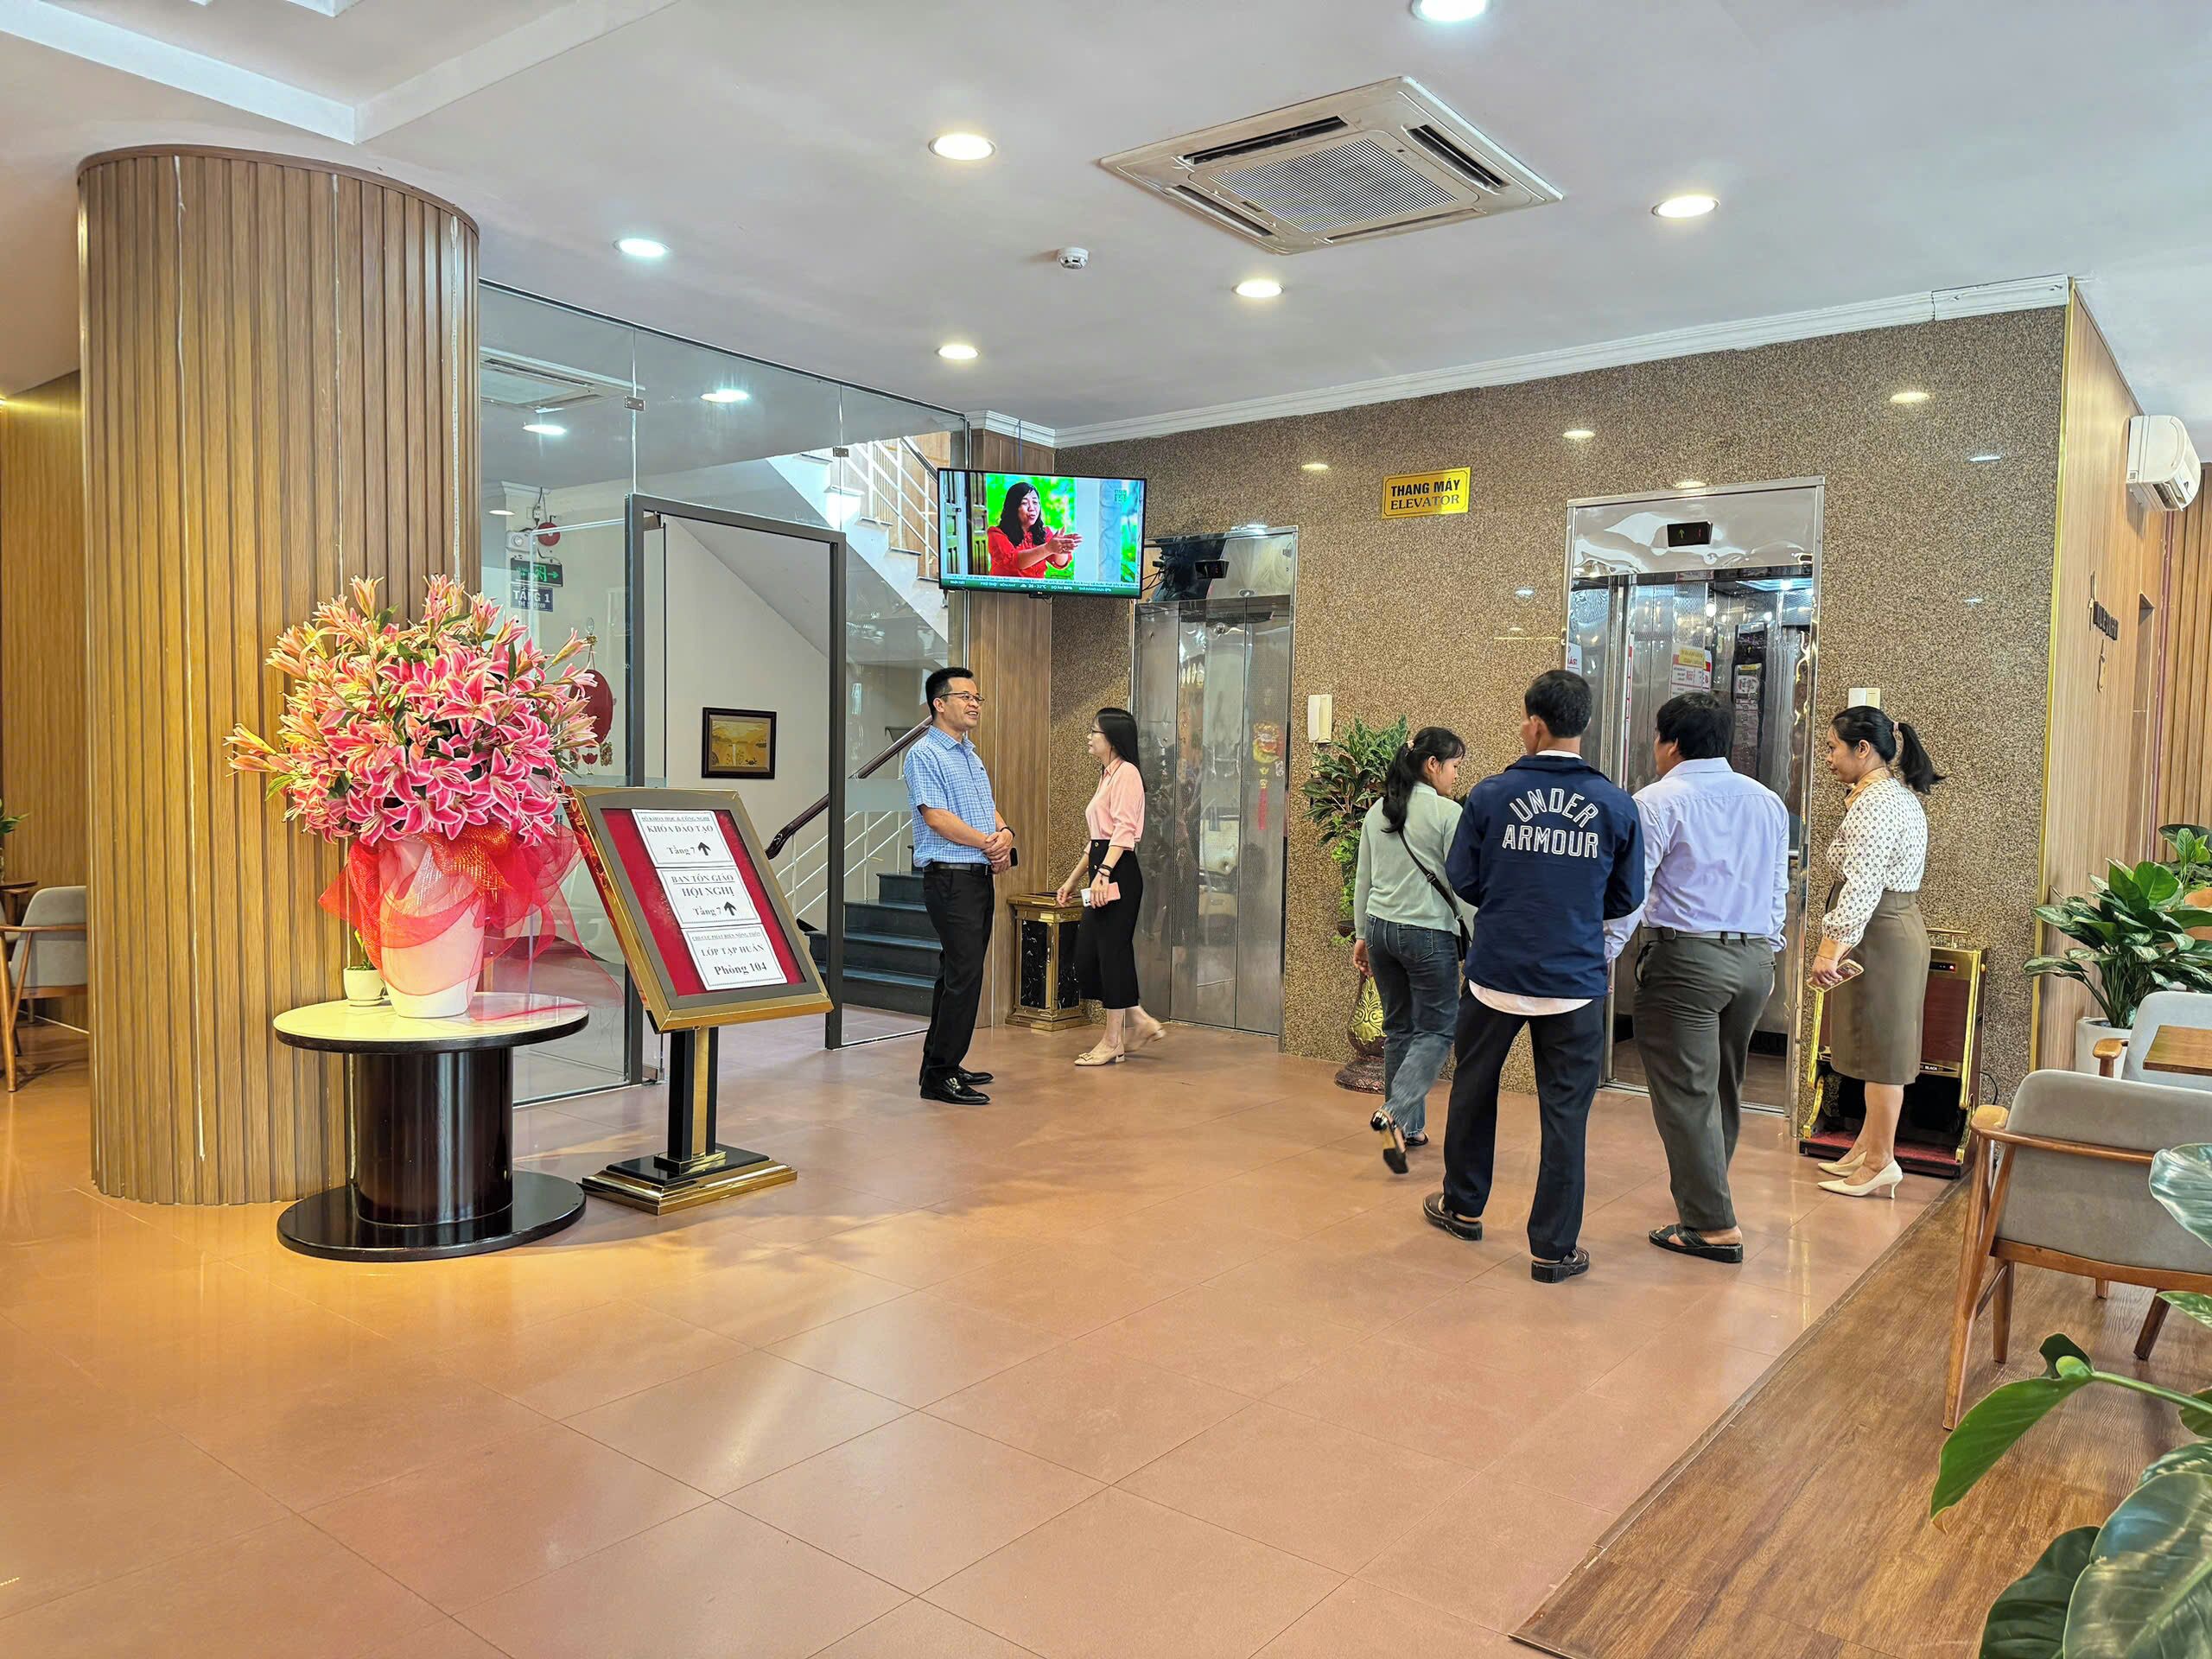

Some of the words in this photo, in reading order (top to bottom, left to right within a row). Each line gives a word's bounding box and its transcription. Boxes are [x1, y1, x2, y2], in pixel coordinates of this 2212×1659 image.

[1391, 482, 1430, 497] THANG
[1433, 478, 1460, 493] MÁY
[1390, 494, 1459, 510] ELEVATOR
[512, 587, 541, 602] TẦG
[544, 593, 550, 603] 1
[1510, 788, 1599, 828] UNDER
[646, 823, 674, 833] KHÓA
[695, 824, 714, 833] TẠO
[1502, 824, 1599, 859] ARMOUR
[667, 845, 690, 855] Tầng
[711, 873, 734, 881] GIÁO
[682, 887, 703, 898] HỘI
[705, 887, 734, 896] NGHỊ
[692, 906, 716, 916] Tầng
[701, 947, 719, 957] LỚP
[714, 964, 749, 976] Phòng
[749, 962, 767, 972] 104
